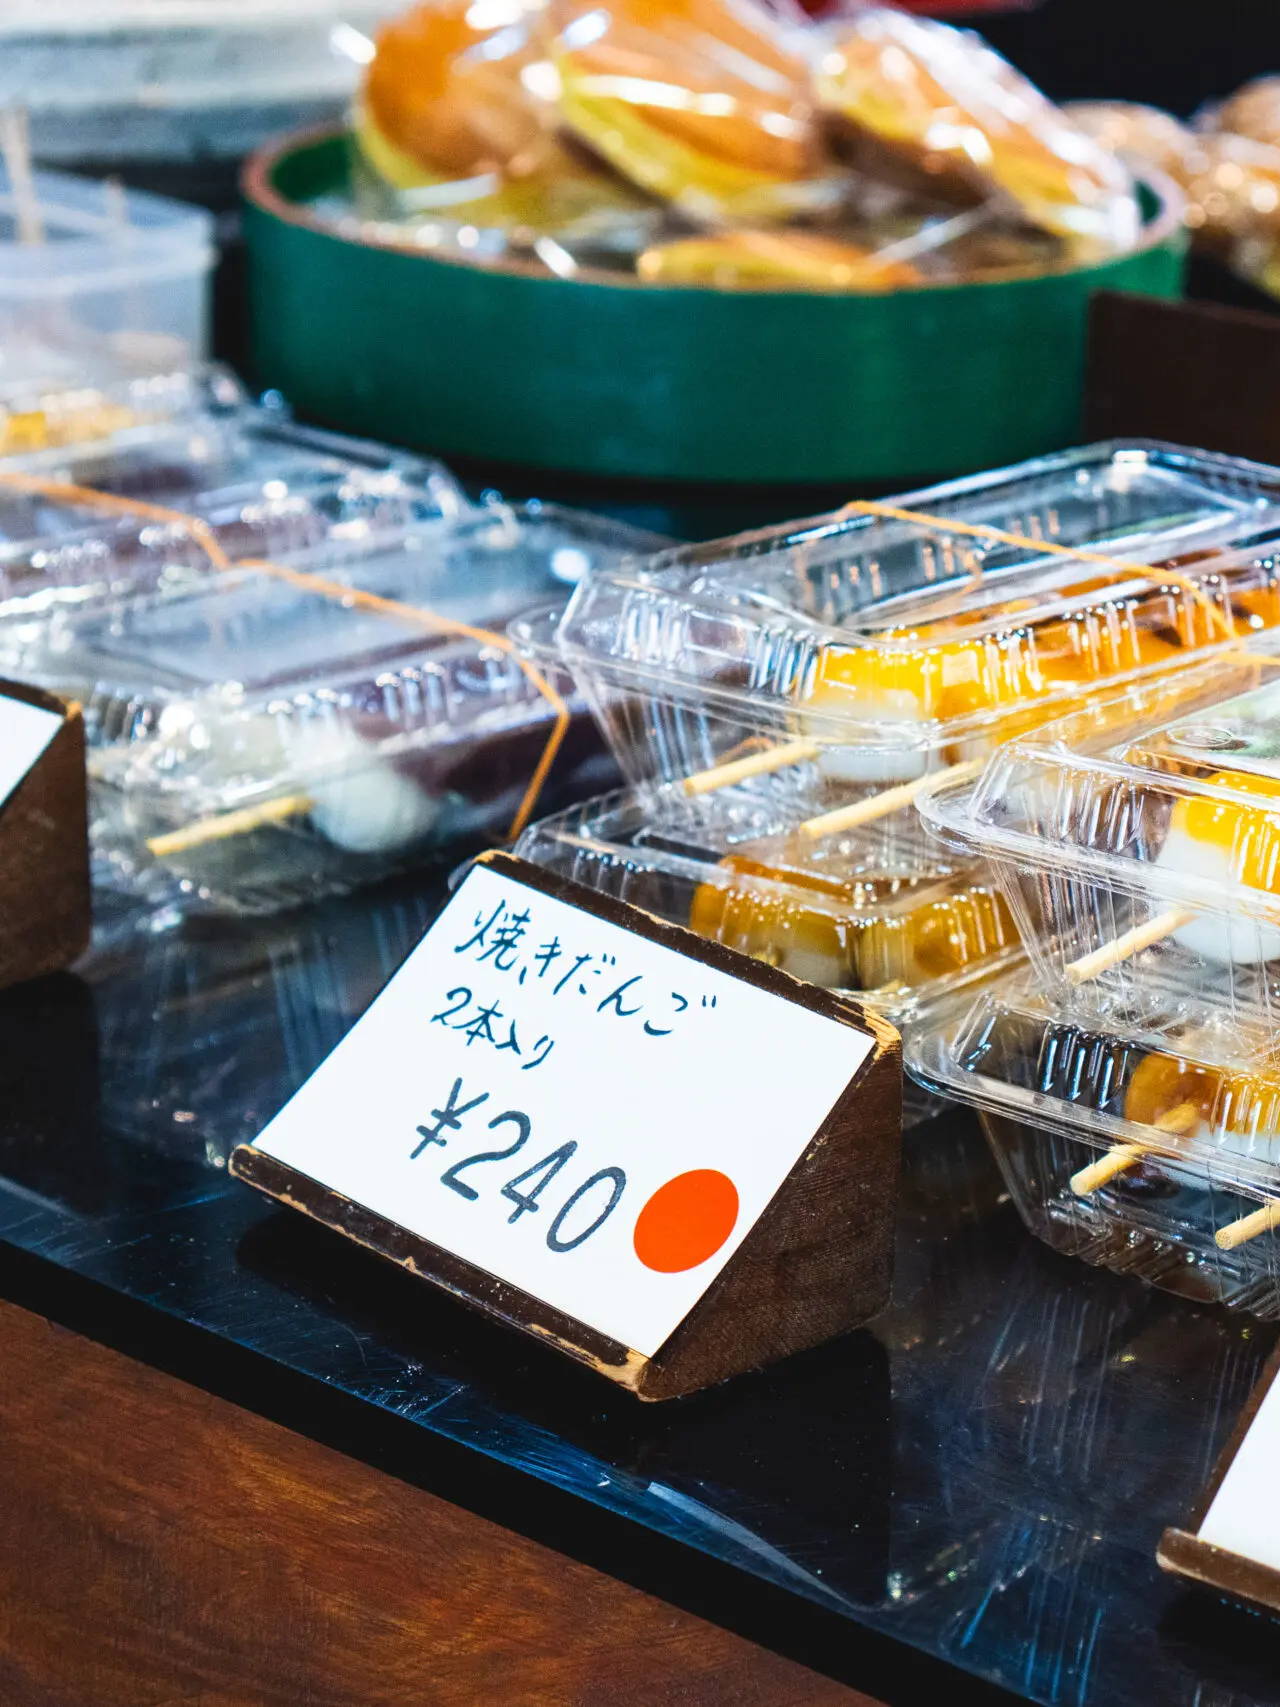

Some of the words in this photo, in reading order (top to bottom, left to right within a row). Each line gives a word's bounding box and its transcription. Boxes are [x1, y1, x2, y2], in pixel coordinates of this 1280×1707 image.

[430, 986, 555, 1070] 2本入り
[454, 899, 718, 1036] 焼きだんご
[409, 1076, 628, 1253] ¥240
